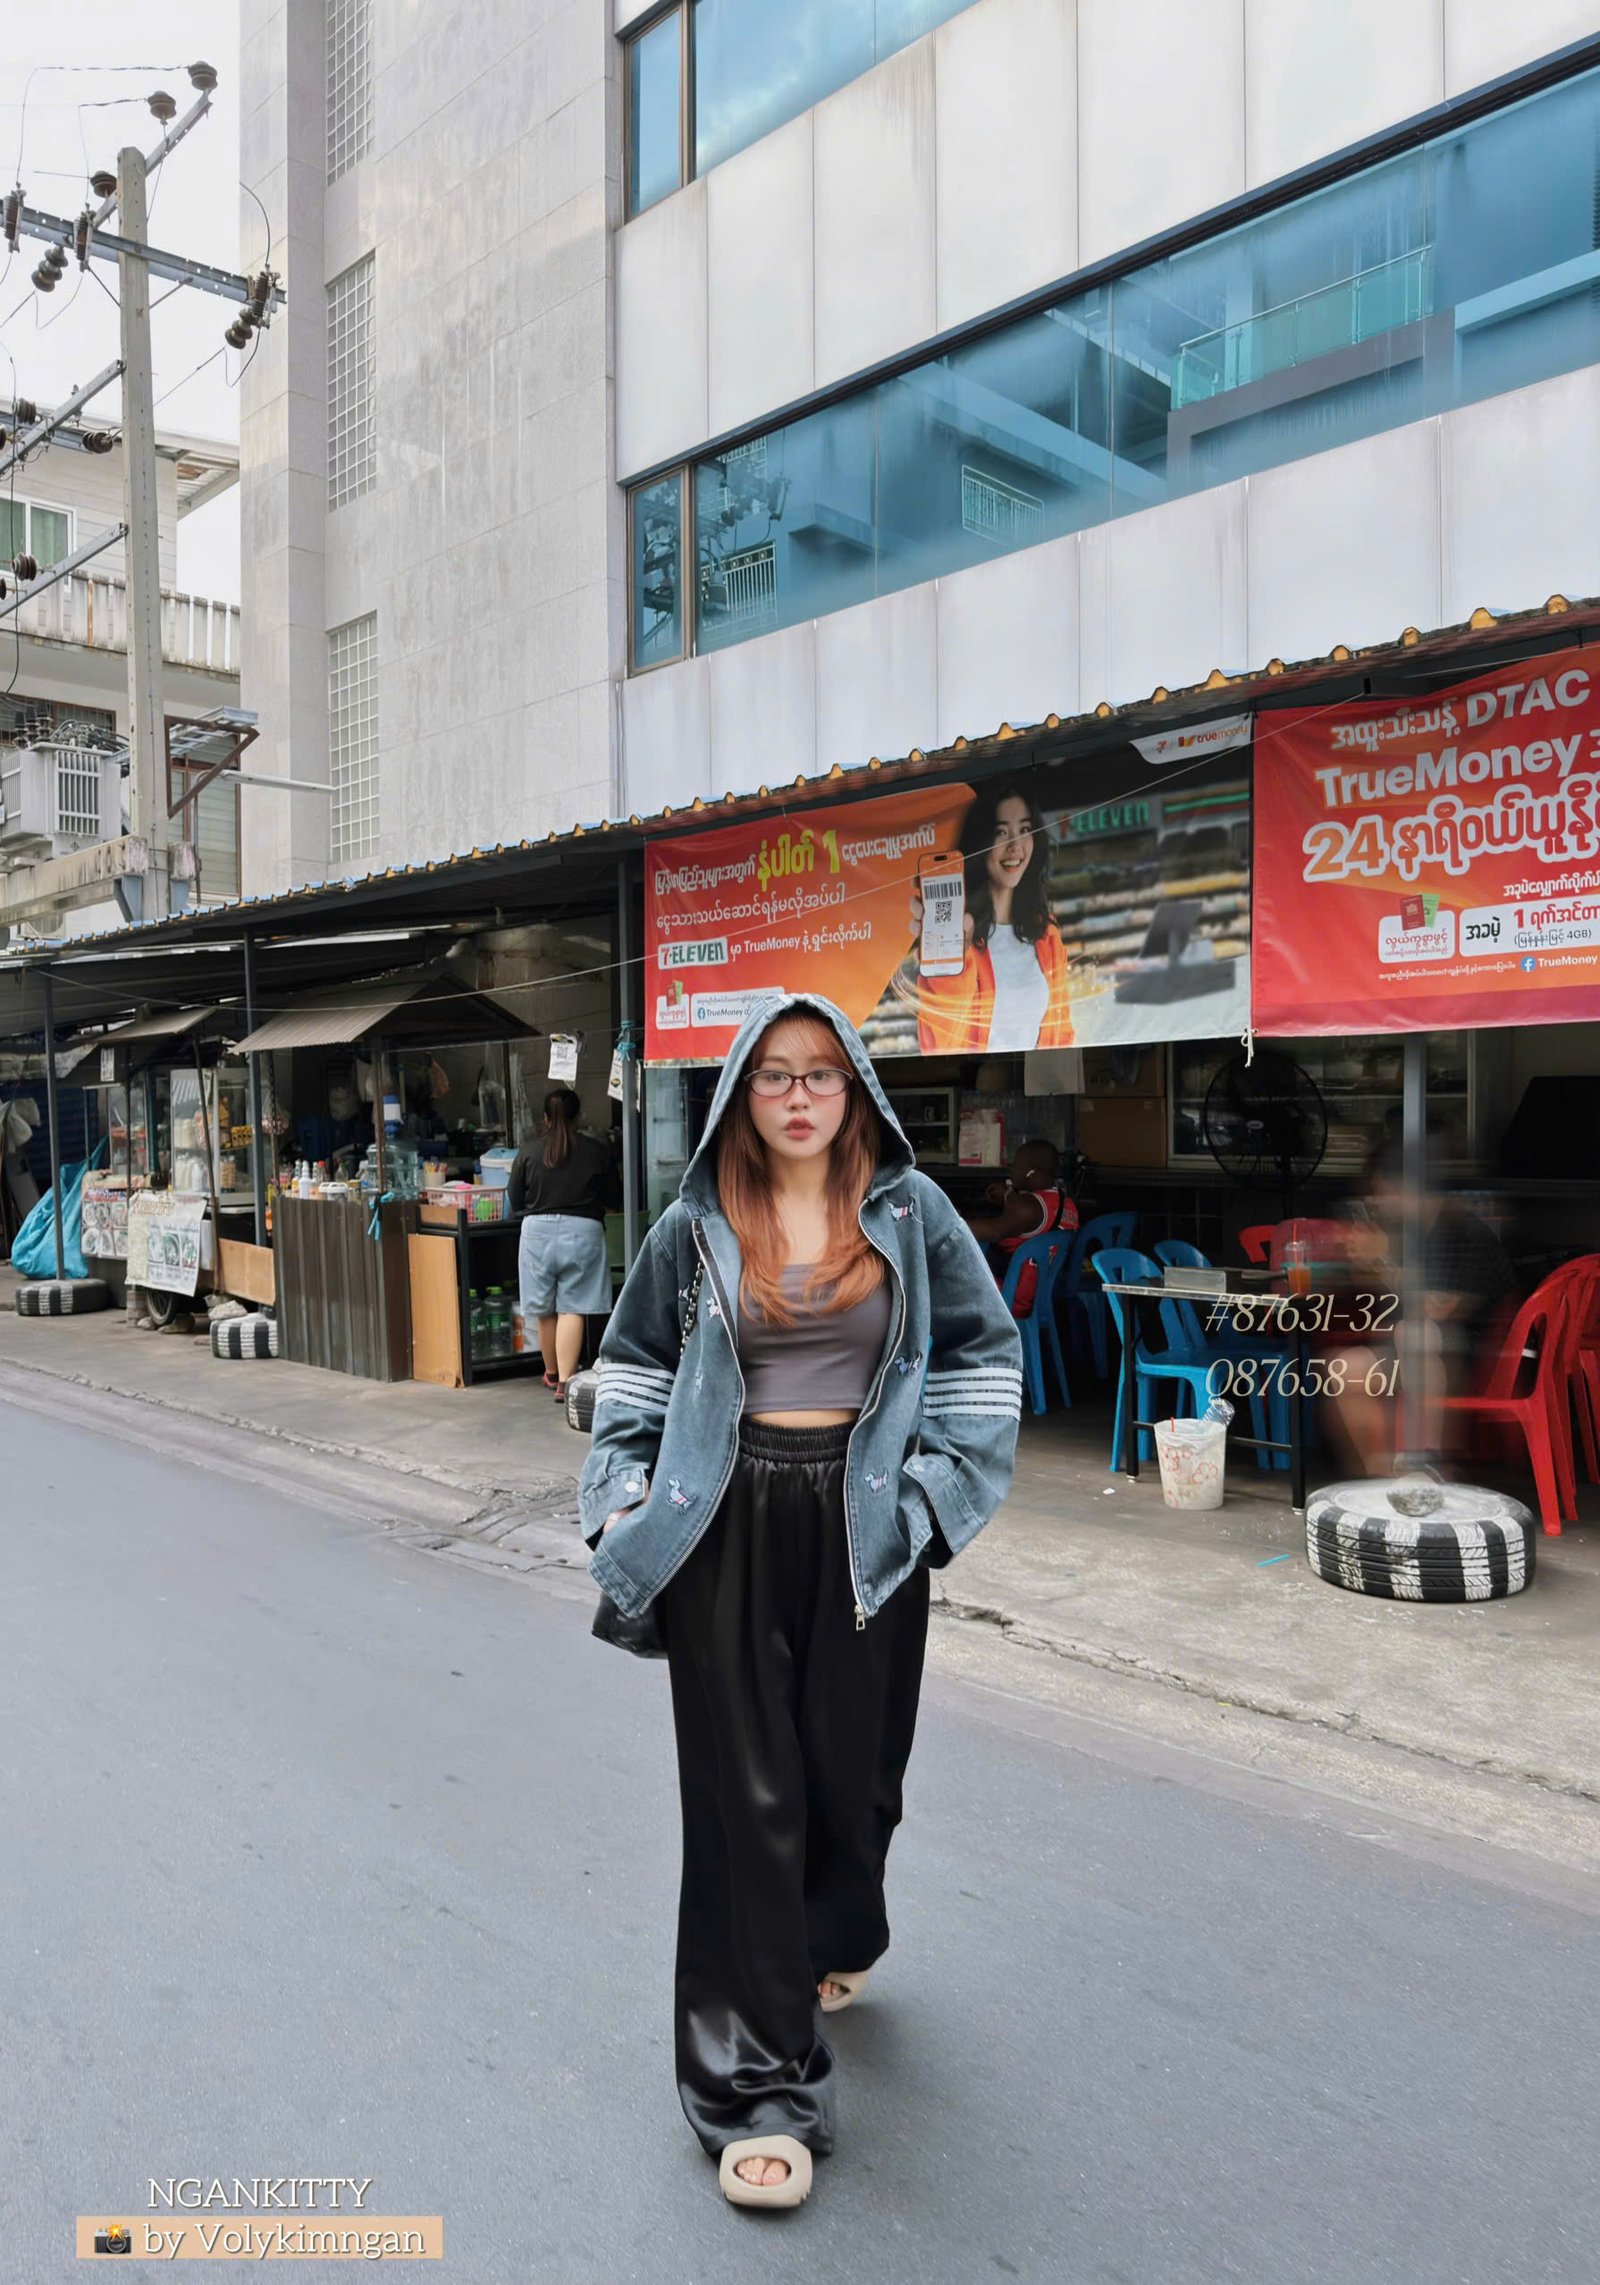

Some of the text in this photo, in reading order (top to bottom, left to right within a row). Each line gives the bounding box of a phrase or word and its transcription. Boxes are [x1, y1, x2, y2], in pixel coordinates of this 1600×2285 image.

[1466, 669, 1591, 728] DTAC
[1197, 723, 1248, 744] truemoney
[1315, 733, 1583, 808] TrueMoney
[822, 828, 841, 875] 1
[1303, 815, 1390, 883] 24
[1513, 908, 1525, 929] 1
[744, 936, 801, 954] TrueMoney
[1566, 928, 1593, 943] 4GB)
[1538, 955, 1598, 968] TrueMoney
[706, 1008, 744, 1017] TrueMoney
